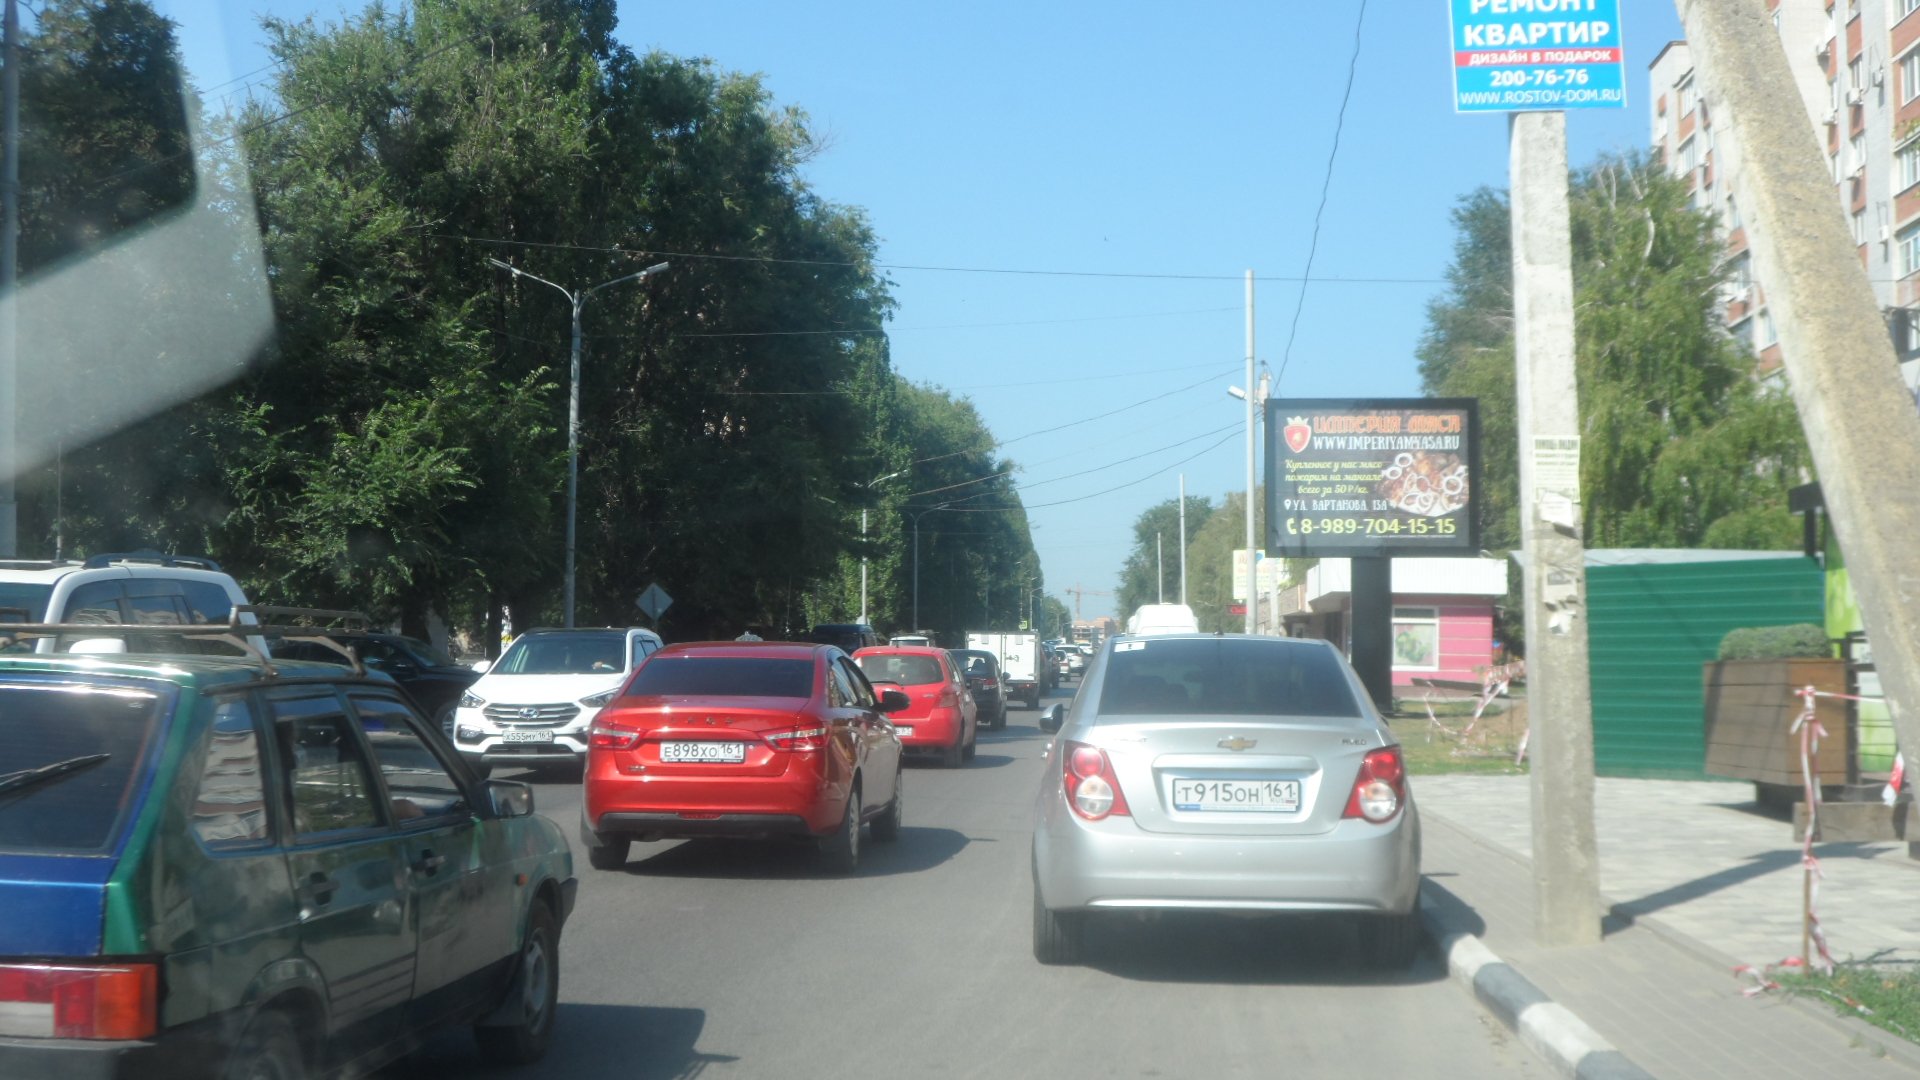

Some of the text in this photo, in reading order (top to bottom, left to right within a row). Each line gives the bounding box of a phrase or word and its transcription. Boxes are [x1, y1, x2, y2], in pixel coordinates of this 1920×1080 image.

[1463, 21, 1610, 46] КВАРТИР
[1469, 50, 1612, 66] ДИЗАЙН В ПОДАРОК
[1490, 69, 1589, 86] 200-76-76
[1460, 88, 1622, 104] WWW.ROSTOV-DOM.RU
[1333, 462, 1340, 472] у
[1301, 518, 1456, 535] 8-989-704-15-15
[664, 744, 740, 758] Е898ХО 161
[1181, 783, 1293, 803] Т915ОН 161
